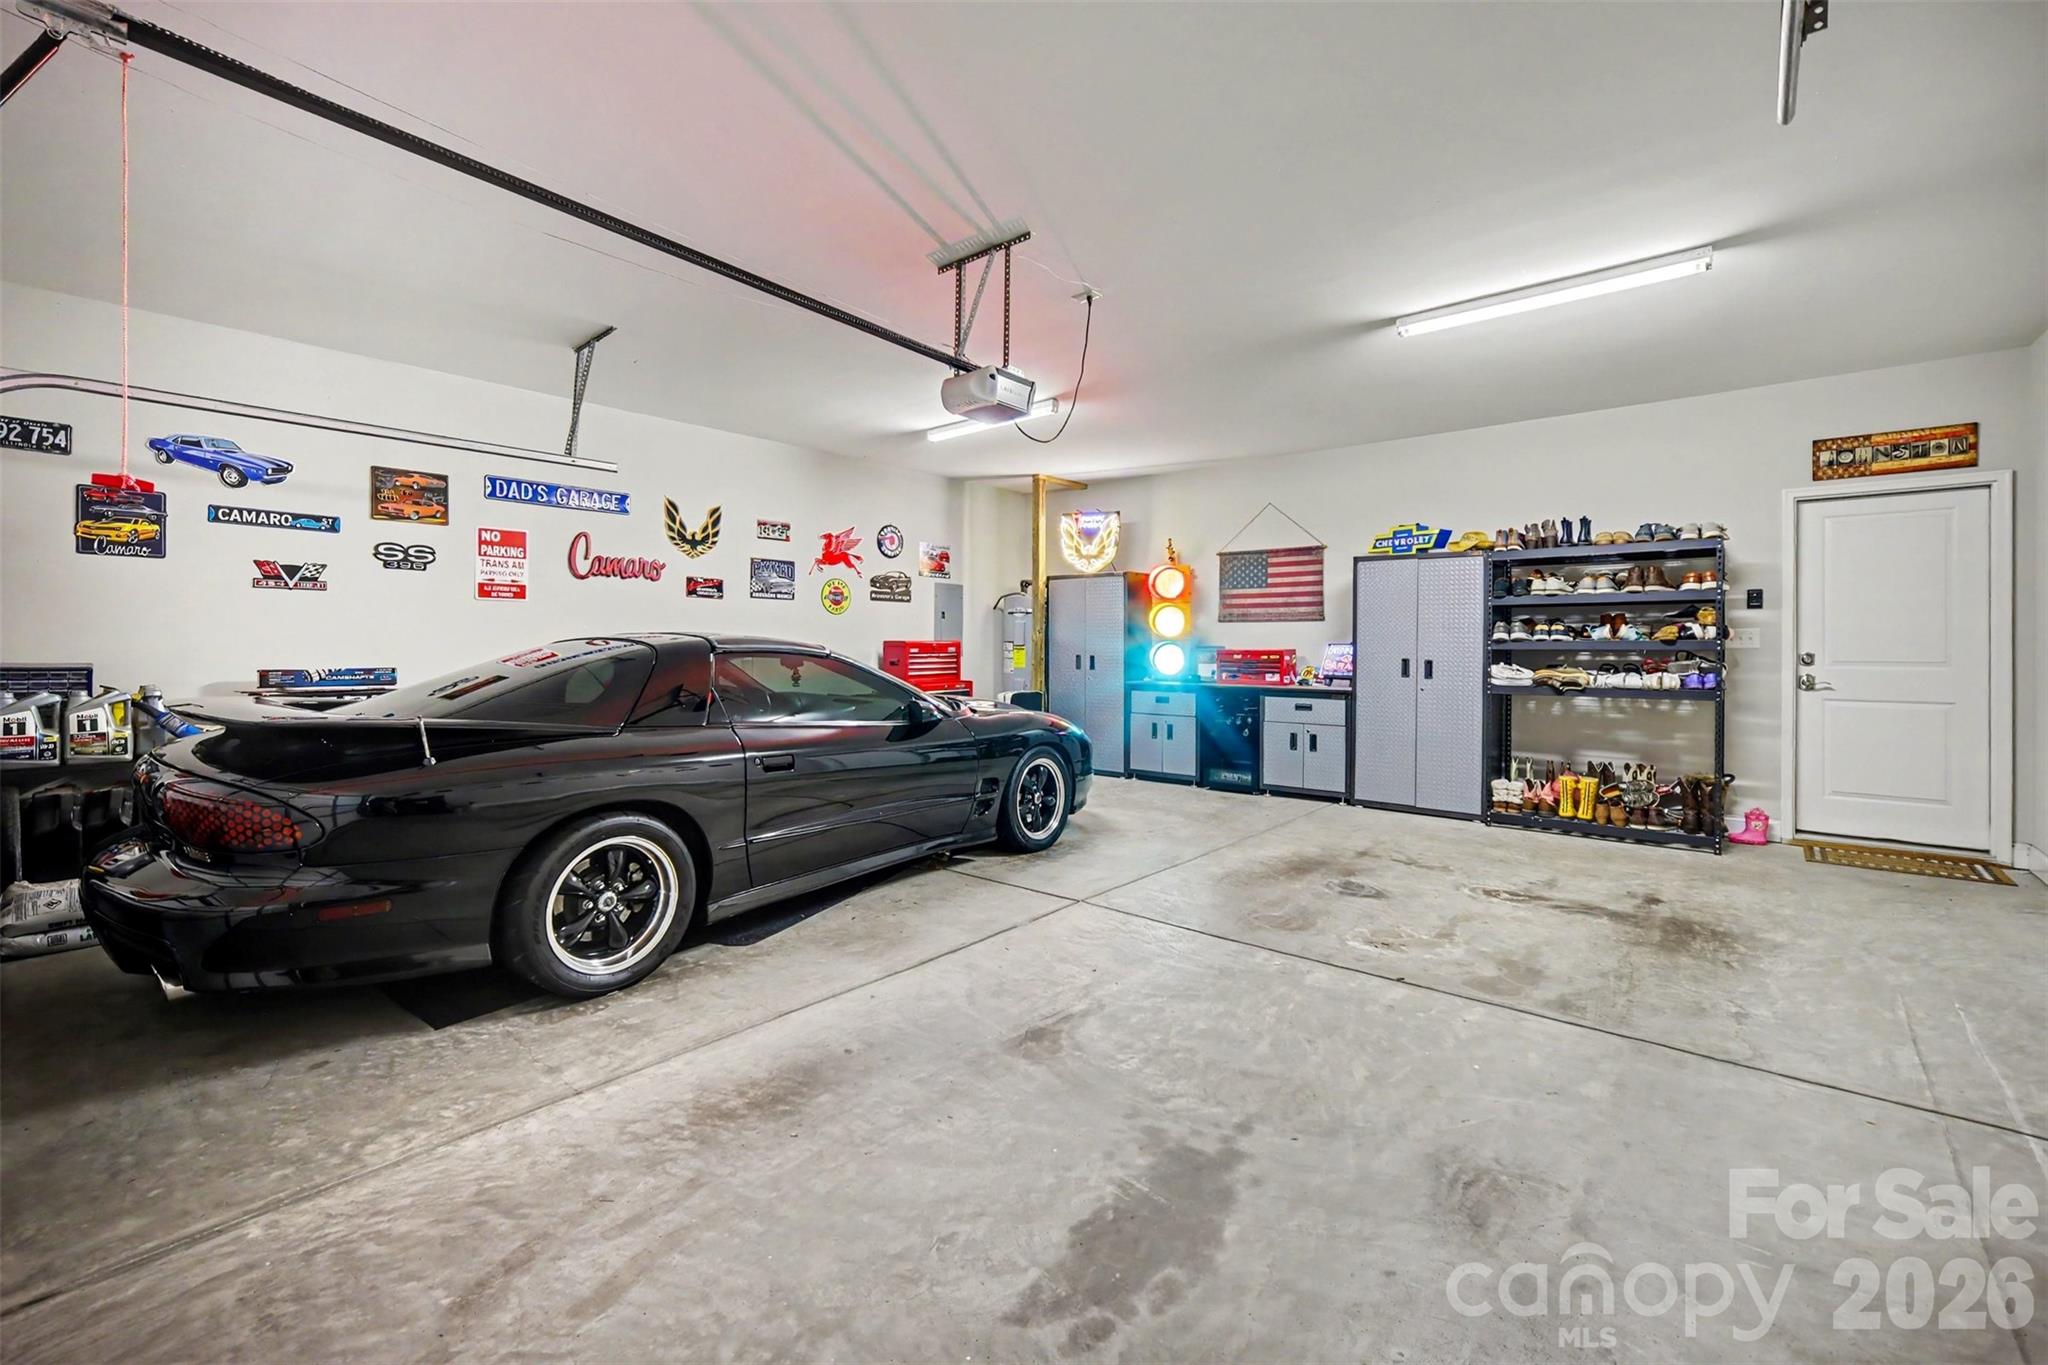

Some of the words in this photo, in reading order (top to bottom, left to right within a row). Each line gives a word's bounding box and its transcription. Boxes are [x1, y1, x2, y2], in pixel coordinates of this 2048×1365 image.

[29, 426, 67, 448] 754
[495, 479, 549, 502] DAD'S
[556, 487, 622, 512] GARAGE
[218, 508, 293, 526] CAMARO
[321, 517, 334, 526] ST
[481, 530, 501, 542] NO
[1375, 535, 1430, 548] CHEVROLET
[94, 535, 152, 557] Camaro
[373, 542, 436, 563] SS
[481, 545, 524, 558] PARKING
[386, 560, 425, 570] 396
[480, 559, 509, 569] TRANS
[512, 560, 525, 569] AM
[568, 531, 667, 582] Camaro
